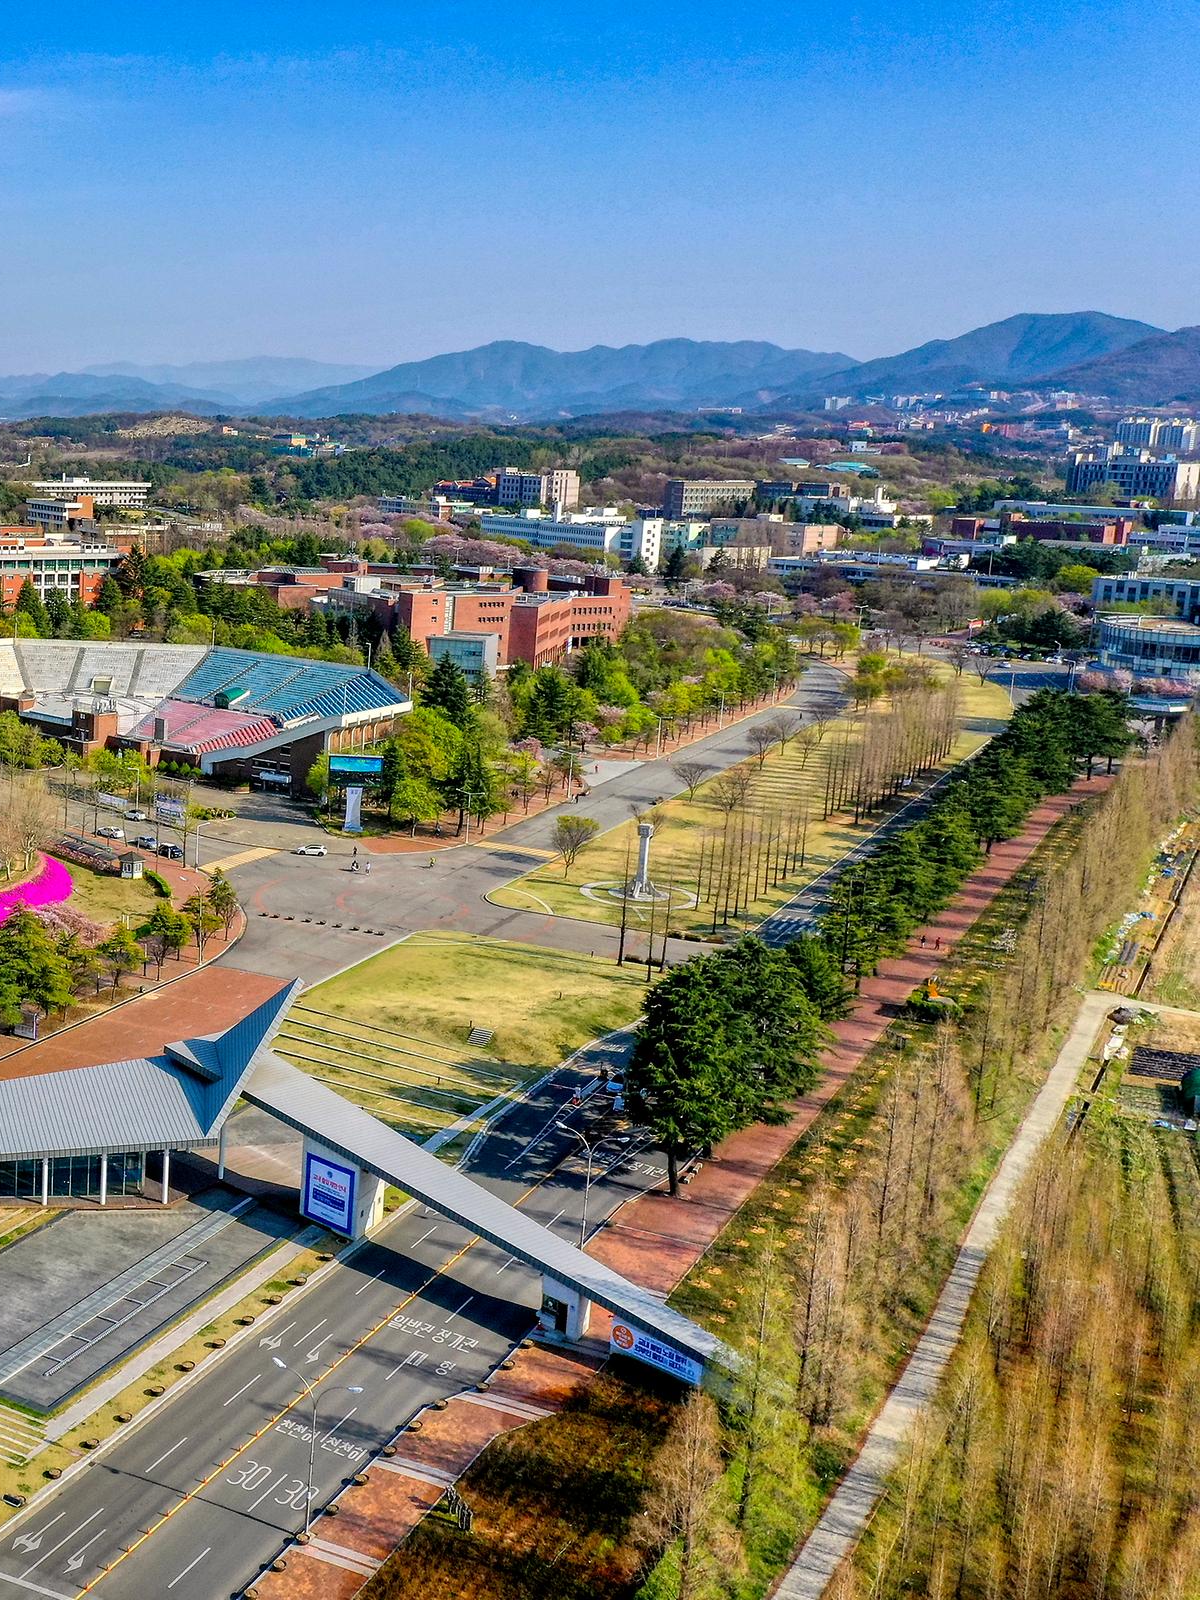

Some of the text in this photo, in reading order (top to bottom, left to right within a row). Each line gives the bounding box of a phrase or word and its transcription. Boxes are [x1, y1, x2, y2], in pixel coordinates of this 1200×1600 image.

[387, 1314, 479, 1354] 일반권 정기권
[275, 1420, 368, 1462] 천천히 천천히
[226, 1460, 320, 1510] 30 30
